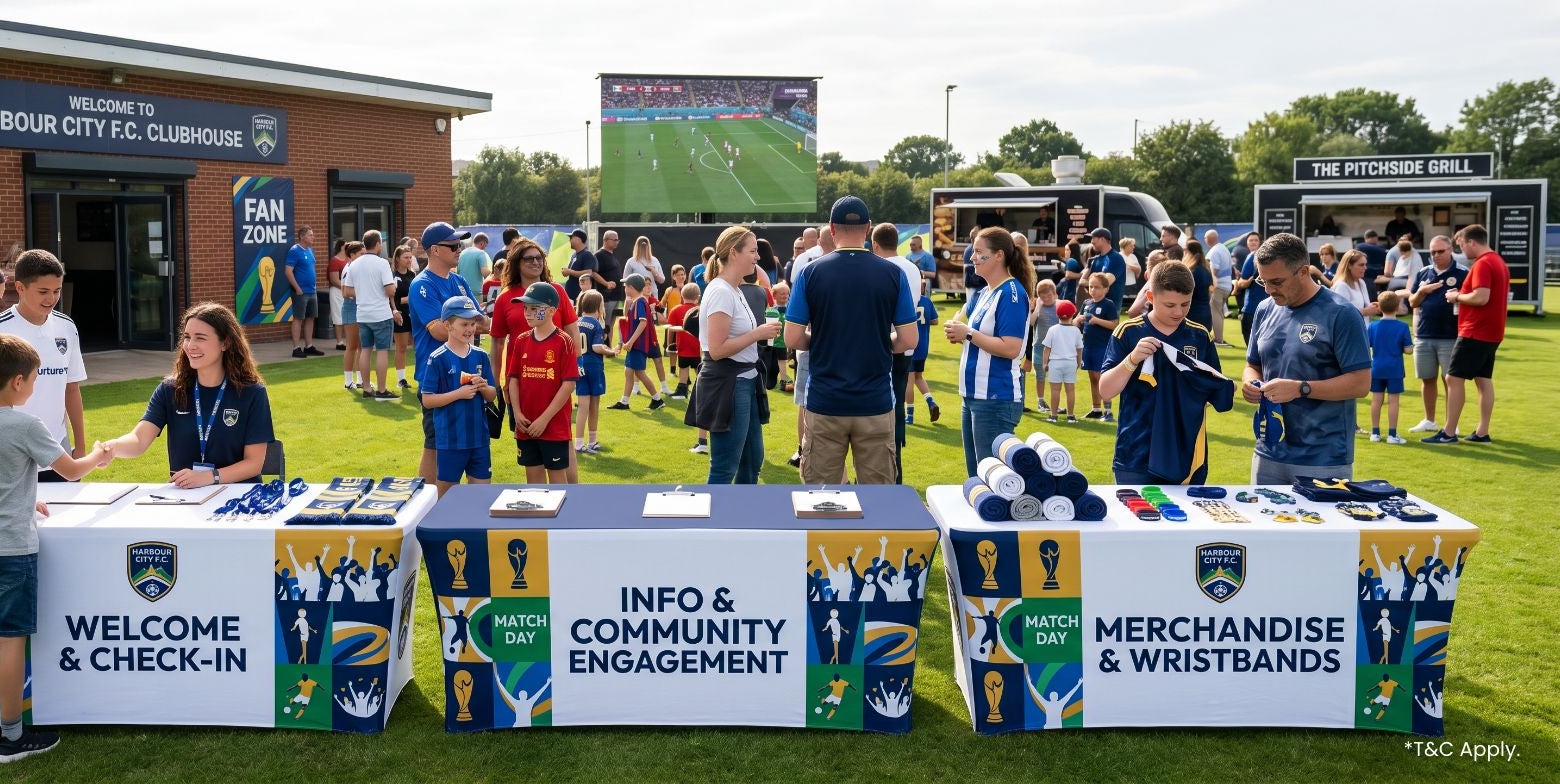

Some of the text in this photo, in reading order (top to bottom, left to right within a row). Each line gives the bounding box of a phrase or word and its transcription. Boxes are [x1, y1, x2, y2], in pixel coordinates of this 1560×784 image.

[69, 96, 155, 117] WELCOME TO
[62, 116, 106, 138] CITY
[111, 120, 142, 141] F.C.
[147, 123, 243, 148] CLUBHOUSE
[1312, 159, 1473, 177] THE PITCHSIDE GRILL
[245, 198, 284, 222] FAN
[243, 225, 287, 243] ZONE
[132, 548, 171, 556] HARBOUR
[621, 586, 736, 613] INFO &
[65, 615, 241, 641] WELCOME
[494, 614, 547, 628] MATCH
[570, 618, 786, 645] COMMUNITY
[1025, 614, 1079, 628] MATCH
[1095, 616, 1345, 642] MERCHANDISE
[505, 631, 536, 644] DAY
[1036, 631, 1068, 645] DAY
[59, 646, 247, 672] & CHECK-IN
[569, 649, 788, 674] ENGAGEMENT
[1098, 648, 1341, 674] & WRISTBANDS
